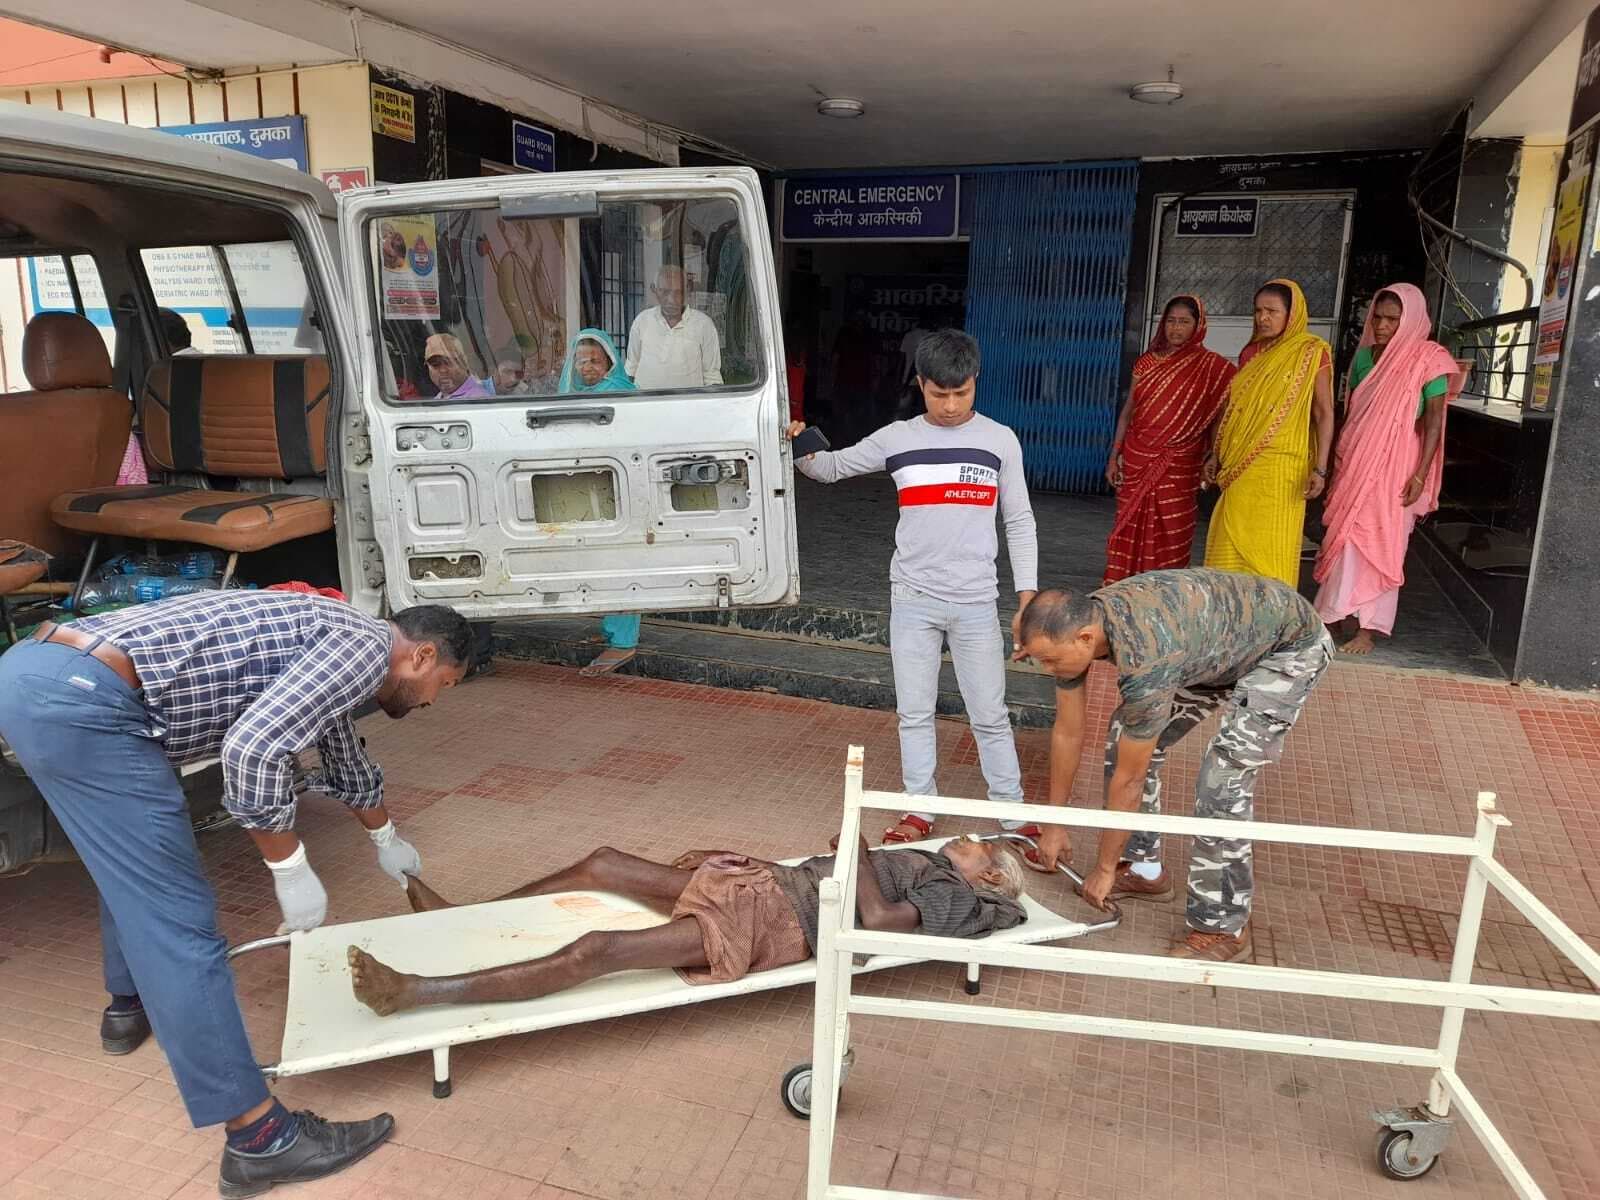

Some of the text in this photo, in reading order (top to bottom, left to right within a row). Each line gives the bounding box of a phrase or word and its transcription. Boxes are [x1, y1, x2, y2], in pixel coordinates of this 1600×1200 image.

[386, 92, 399, 106] CCTV
[250, 125, 291, 147] दुमका
[516, 135, 552, 153] GUARD ROOM
[794, 185, 945, 205] CENTRAL EMERGENCY
[812, 207, 922, 227] केन्द्रीय आकस्मिकी
[1181, 204, 1254, 231] आयुष्मान कियोस्क
[153, 263, 205, 273] PHYSIOTHERAPY
[153, 277, 182, 286] DIALYSIS
[189, 289, 209, 297] WARD
[944, 490, 977, 499] ATHLETIC
